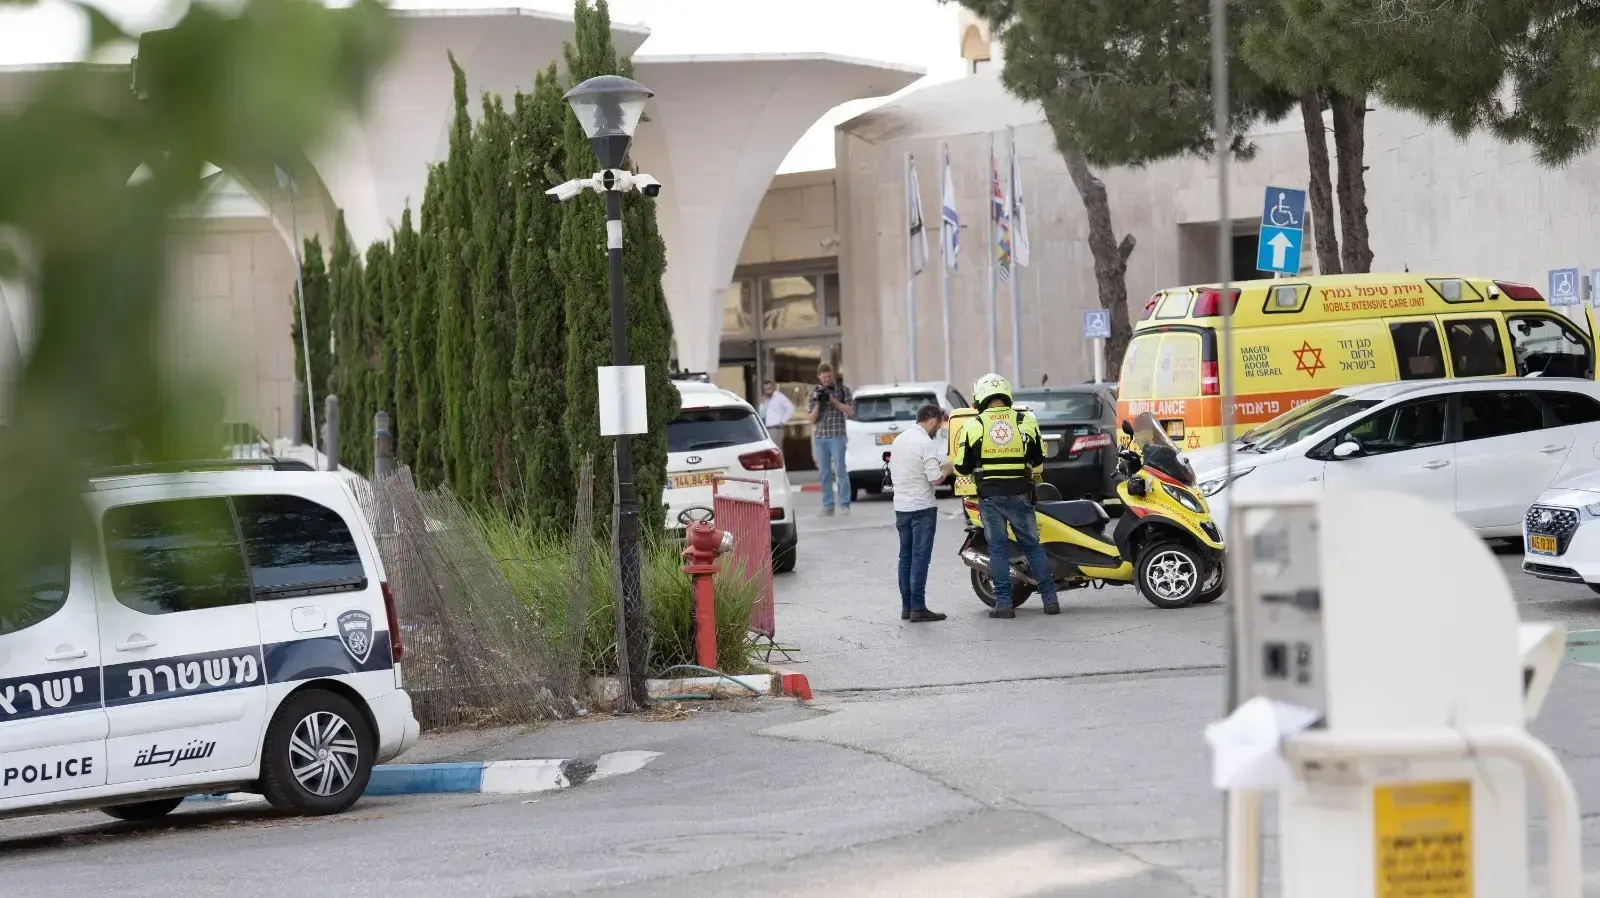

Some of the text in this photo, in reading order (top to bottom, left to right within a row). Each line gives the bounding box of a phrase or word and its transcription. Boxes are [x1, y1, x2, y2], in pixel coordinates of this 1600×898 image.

[1320, 284, 1423, 301] ניידת טיפול נמרץ
[1322, 297, 1425, 312] MOBILE INTENSIVE CARE UNIT
[1240, 345, 1270, 355] MAGEN
[1338, 338, 1372, 350] מגן דוד
[1242, 353, 1268, 362] DAVID
[1350, 349, 1374, 359] אדום
[1244, 361, 1270, 370] ADOM
[1339, 359, 1376, 371] בישראל
[1245, 367, 1283, 378] IN ISRAEL
[128, 655, 258, 697] משטרת
[133, 738, 217, 768] الشرطة
[4, 756, 93, 786] POLICE
